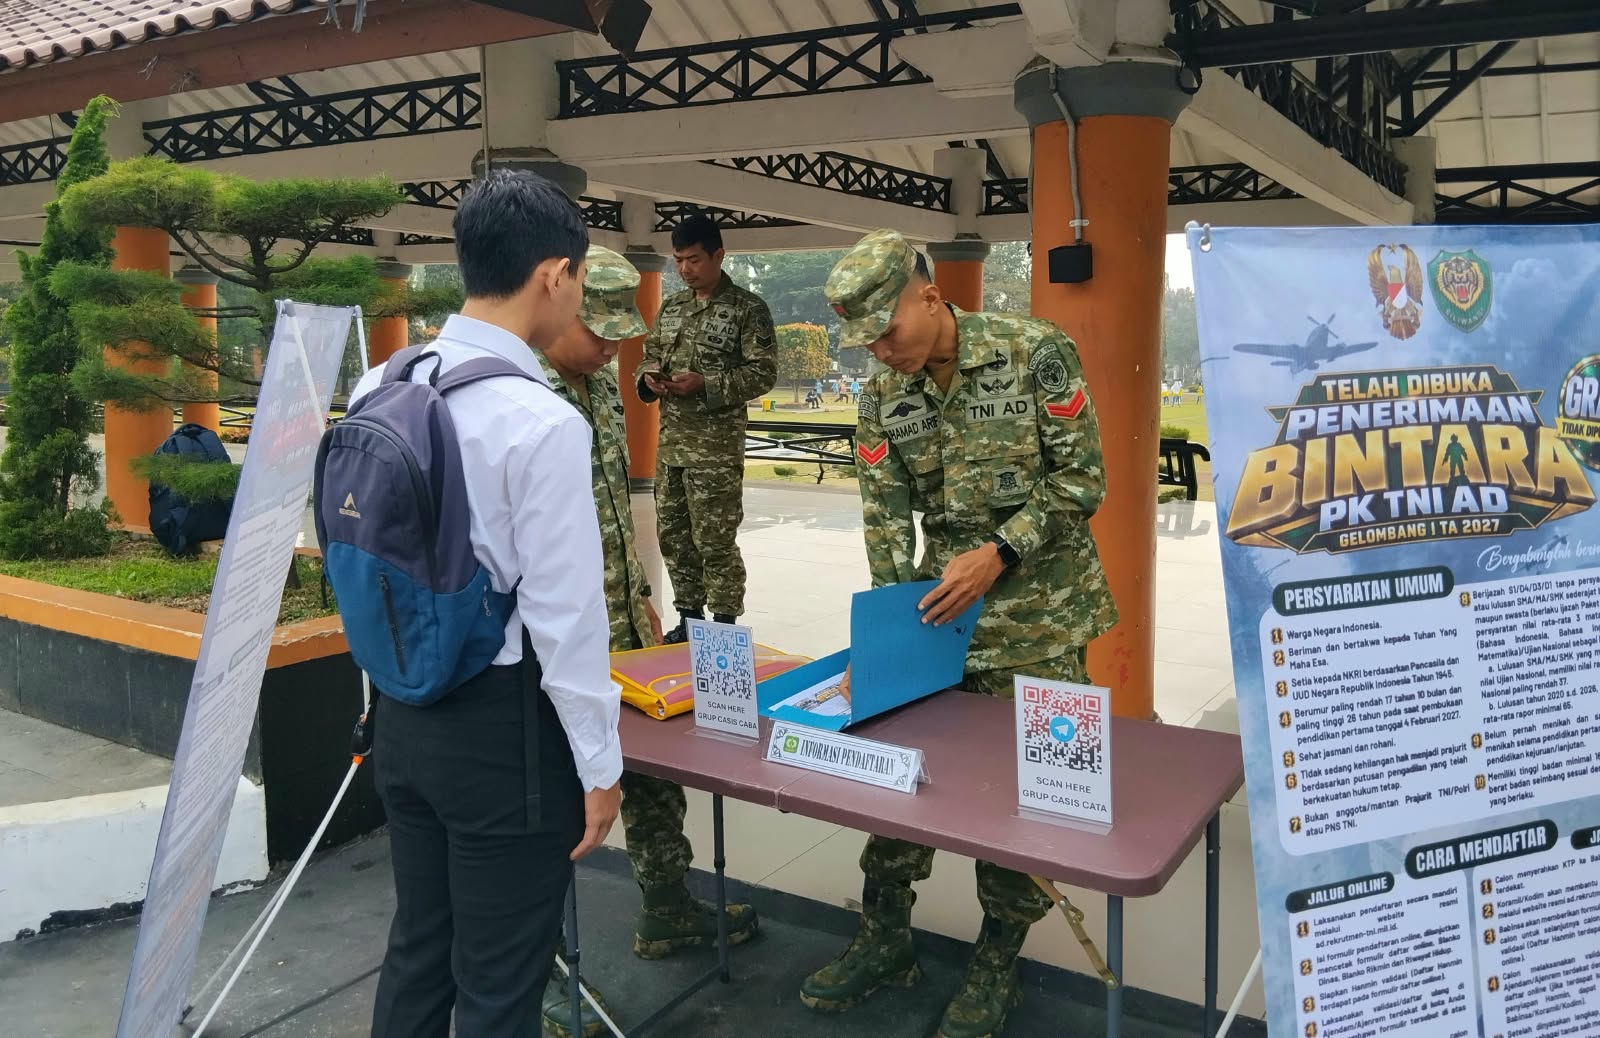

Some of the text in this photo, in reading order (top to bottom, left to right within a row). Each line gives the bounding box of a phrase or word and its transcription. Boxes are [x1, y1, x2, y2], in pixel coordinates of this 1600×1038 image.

[1322, 371, 1493, 401] TELAH DIBUKA
[970, 400, 1028, 420] TNI AD
[1285, 395, 1537, 441] PENERIMAAN
[1562, 422, 1585, 437] TIDAK
[1227, 424, 1596, 538] BINTARA
[1319, 485, 1508, 532] PK TNI AD
[1339, 523, 1426, 547] GELOMBANG
[1440, 520, 1458, 535] TA
[1462, 518, 1500, 533] 2027
[1284, 572, 1443, 610] PERSYARATAN UMUM
[1286, 630, 1312, 640] Warga
[1313, 627, 1342, 638] Negara
[1342, 621, 1383, 633] Indonesia.
[1288, 646, 1322, 657] Beriman
[1325, 643, 1341, 652] dan
[1343, 639, 1381, 650] bertakwa
[1383, 634, 1411, 646] kepada
[1414, 631, 1436, 641] Tuhan
[1439, 628, 1458, 638] Yang
[1290, 658, 1329, 670] Maha Esa.
[1291, 677, 1313, 688] Setia
[1313, 673, 1342, 685] kepada
[1342, 670, 1362, 680] NKRI
[1363, 664, 1410, 678] berdasarkan
[1410, 658, 1446, 671] Pancasila
[1446, 657, 1460, 666] dan
[1292, 669, 1454, 701] UUD Negara Republik Indonesia Tahun 1945.
[1481, 677, 1569, 699] Nasional paling rendah 37.
[1489, 685, 1599, 711] b. Lulusan tahun 2020 s.d. 2026,
[708, 701, 745, 714] SCAN HERE
[1294, 707, 1329, 718] Berumur
[1331, 702, 1355, 715] paling
[1357, 697, 1384, 709] rendah
[1385, 695, 1393, 705] 17
[1394, 694, 1416, 703] tahun
[1417, 690, 1426, 699] 10
[1426, 688, 1448, 698] bulan
[1449, 686, 1463, 695] dan
[1296, 699, 1464, 733] paling tinggi 26 tahun pada saat pembukaan
[1483, 701, 1574, 724] rata-rata rapor minimal 65.
[698, 712, 757, 729] GRUP CASIS CABA
[1297, 710, 1461, 747] pendidikan pertama tanggal 4 Februari 2027.
[1484, 731, 1507, 741] Belum
[1512, 724, 1537, 737] pernah
[1542, 718, 1571, 730] menikah
[1576, 715, 1589, 724] dan
[800, 739, 896, 776] INFORMASI PENDAFTARAN
[1299, 751, 1322, 762] Sehat
[1323, 745, 1353, 760] jasmani
[1354, 744, 1369, 753] dan
[1370, 738, 1396, 750] rohani.
[1300, 768, 1323, 779] Tidak
[1324, 764, 1352, 776] sedang
[1353, 757, 1395, 770] kehilangan
[1396, 753, 1410, 763] hak
[1410, 747, 1439, 760] menjadi
[1441, 743, 1467, 757] prajurit
[1487, 753, 1525, 767] pendidikan
[1036, 776, 1091, 794] SCAN HERE
[1302, 755, 1468, 793] berdasarkan putusan pengadilan yang telah
[1022, 789, 1107, 812] GRUP CASIS CATA
[1303, 782, 1402, 806] berkekuatan hukum tetap.
[1305, 813, 1329, 824] Bukan
[1336, 800, 1399, 818] anggota/mantan
[1405, 792, 1433, 804] Prajurit
[1438, 784, 1471, 798] TNI/Polri
[1490, 792, 1535, 808] yang berlaku.
[1306, 819, 1358, 837] atau PNS TNI.
[1416, 826, 1546, 872] CARA MENDAFTAR
[1307, 875, 1388, 906] JALUR ONLINE
